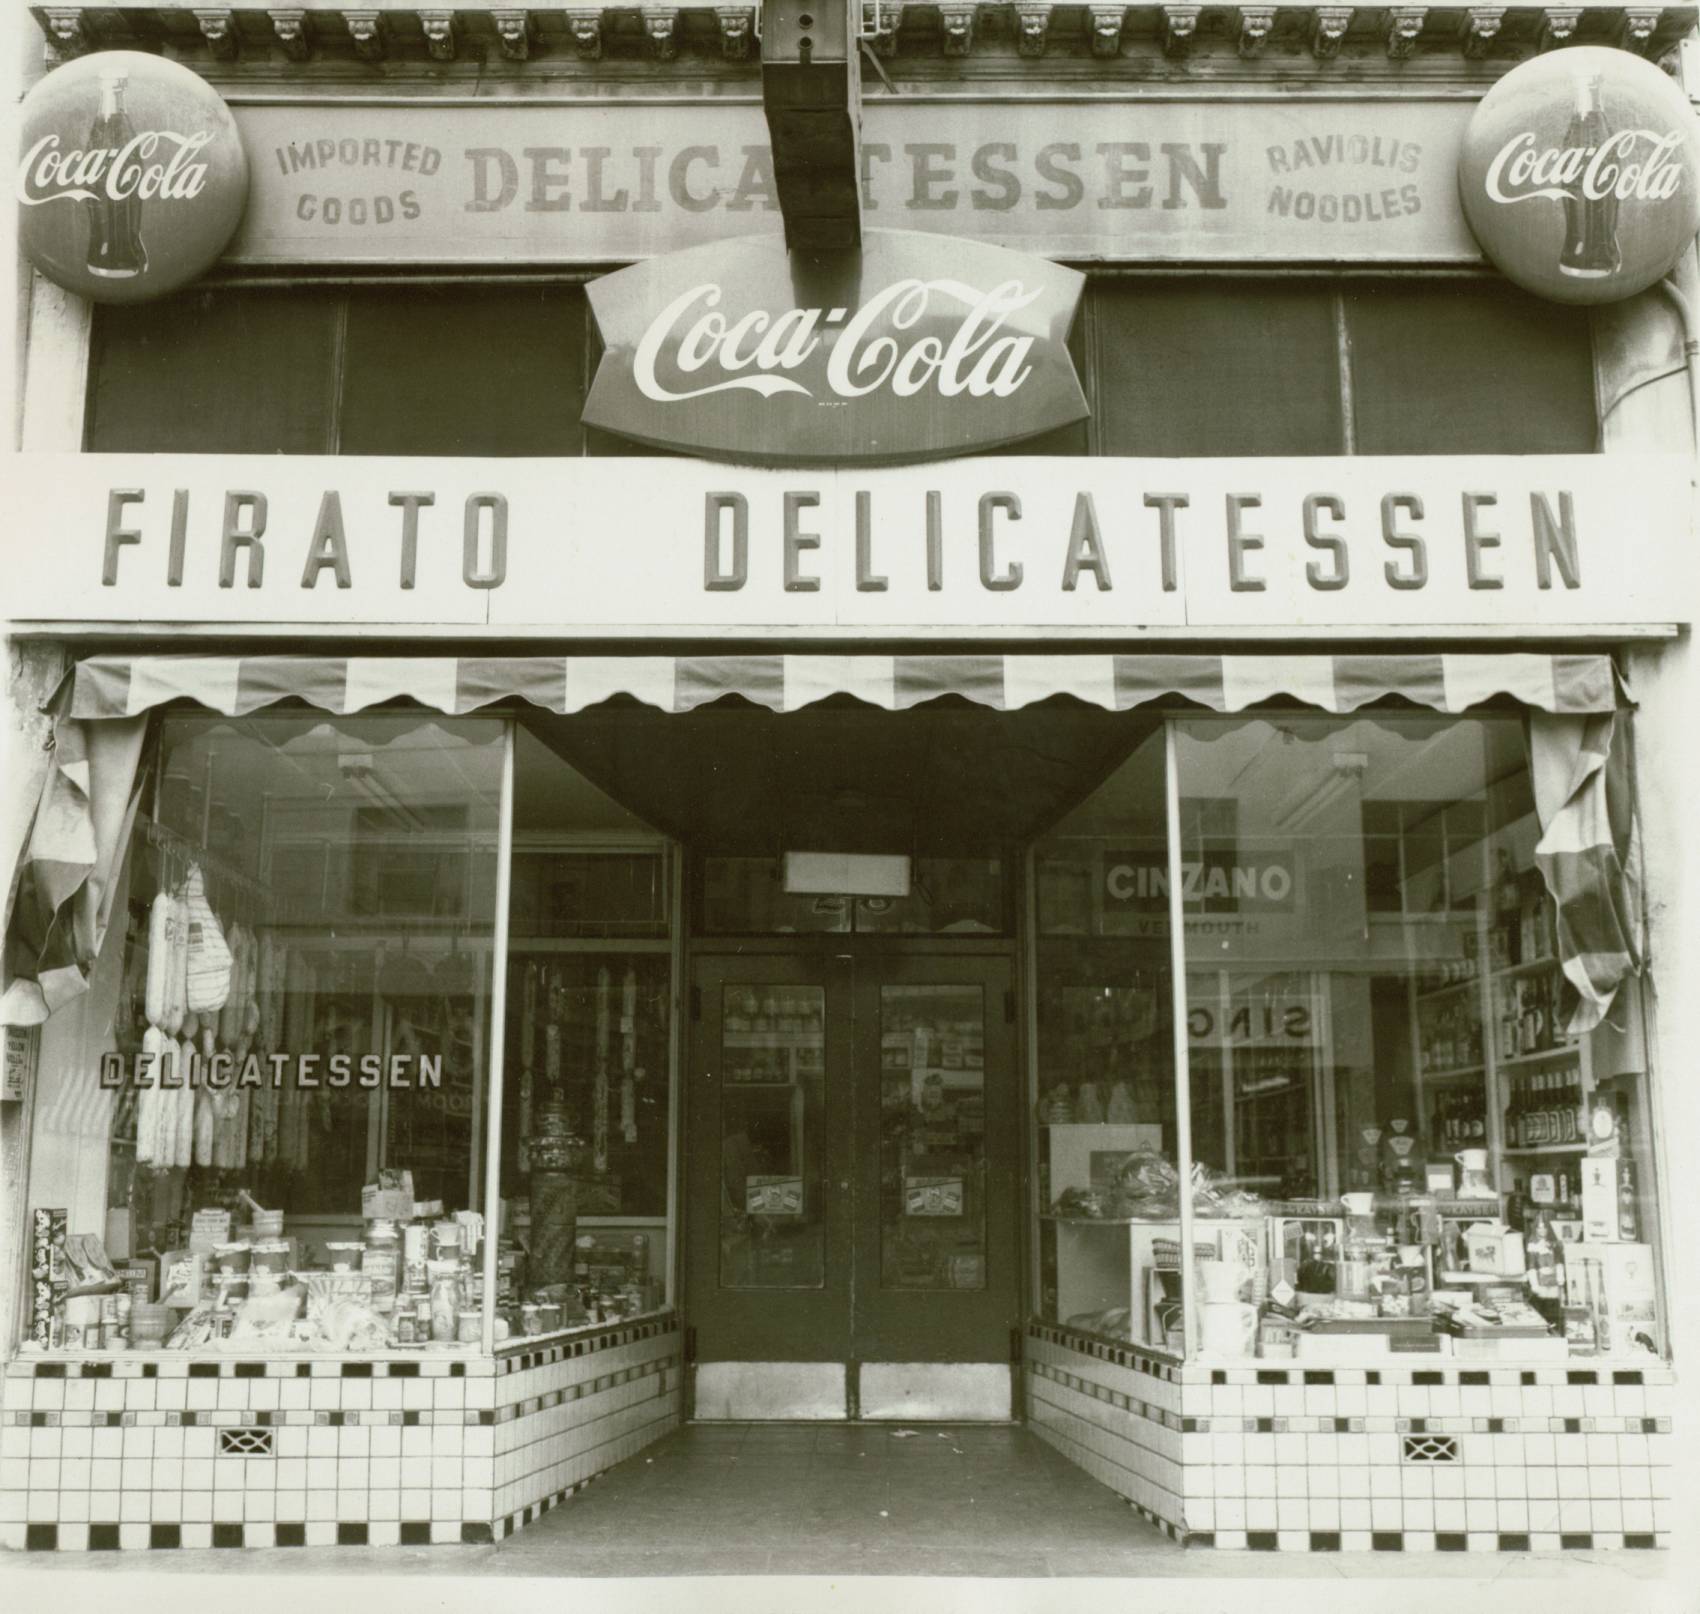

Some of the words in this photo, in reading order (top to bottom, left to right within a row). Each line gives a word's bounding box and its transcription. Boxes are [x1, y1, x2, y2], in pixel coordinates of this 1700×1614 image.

[18, 130, 216, 205] Coca-Cola
[275, 138, 441, 177] IMPORTED
[1266, 134, 1422, 174] RAVIOLIS
[1484, 128, 1686, 204] Coca-Cola
[464, 141, 1228, 213] DELICATESSEN
[296, 190, 421, 226] GOODS
[1267, 185, 1421, 222] NOODLES
[632, 278, 1043, 403] Coca-Cola
[102, 488, 508, 590] FIRATO
[704, 490, 1581, 593] DELICATESSEN
[1107, 862, 1291, 901] CINZANO
[1138, 920, 1260, 935] VEMOUTH
[101, 1052, 443, 1089] DELICATESSEN
